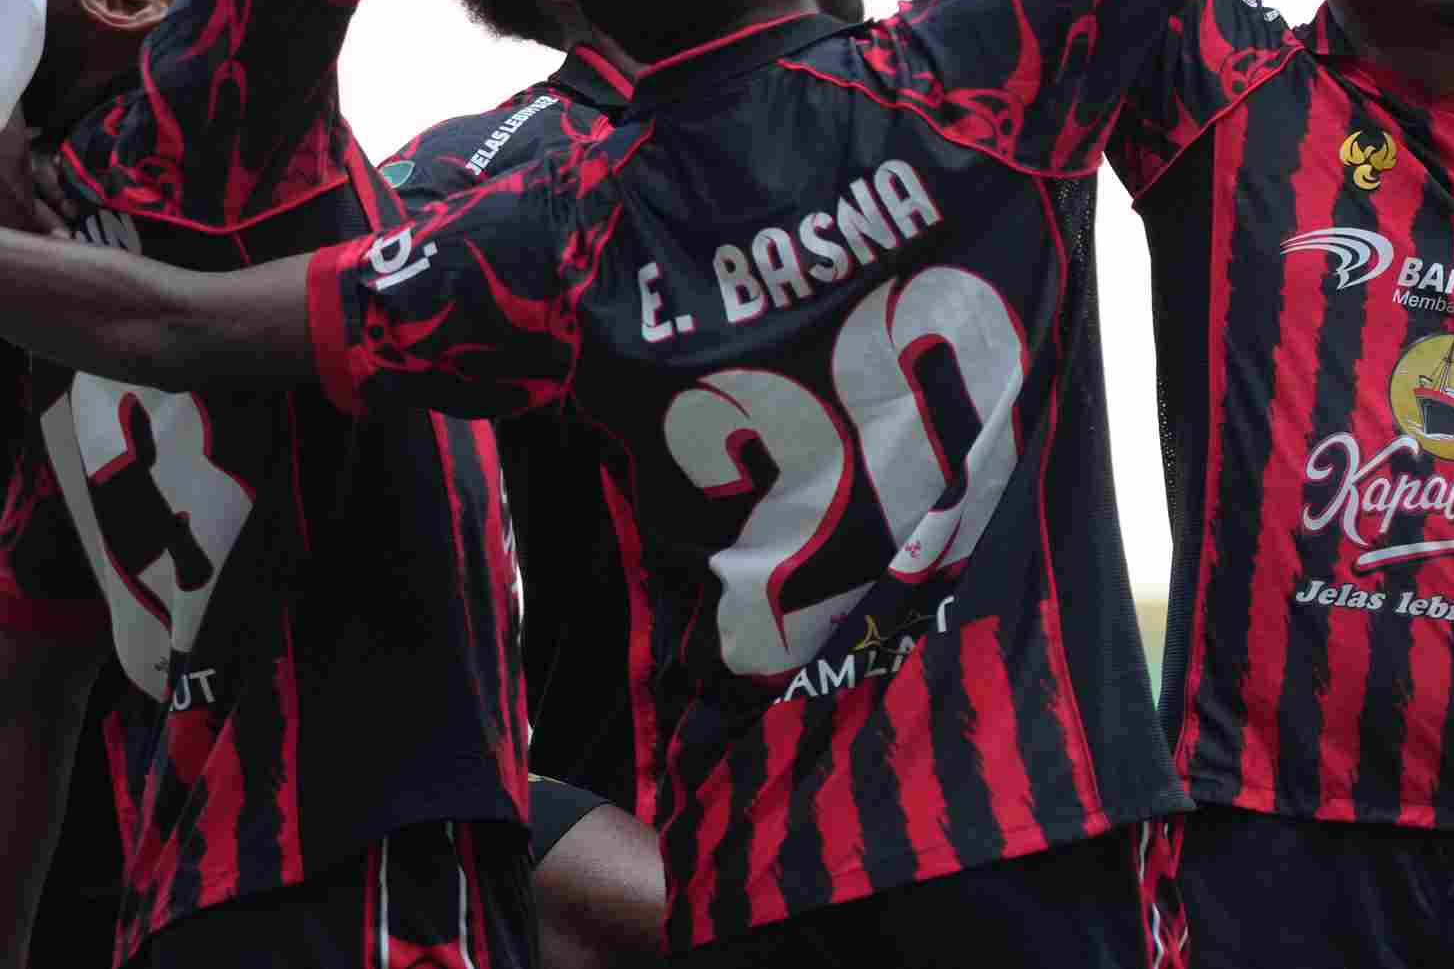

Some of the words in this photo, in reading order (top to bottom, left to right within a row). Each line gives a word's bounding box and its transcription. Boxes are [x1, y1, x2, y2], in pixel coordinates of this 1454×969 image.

[465, 130, 512, 176] JELAS
[638, 261, 696, 344] E.
[712, 159, 942, 325] BASNA
[664, 266, 1030, 681] 20
[1295, 580, 1388, 610] Jelas
